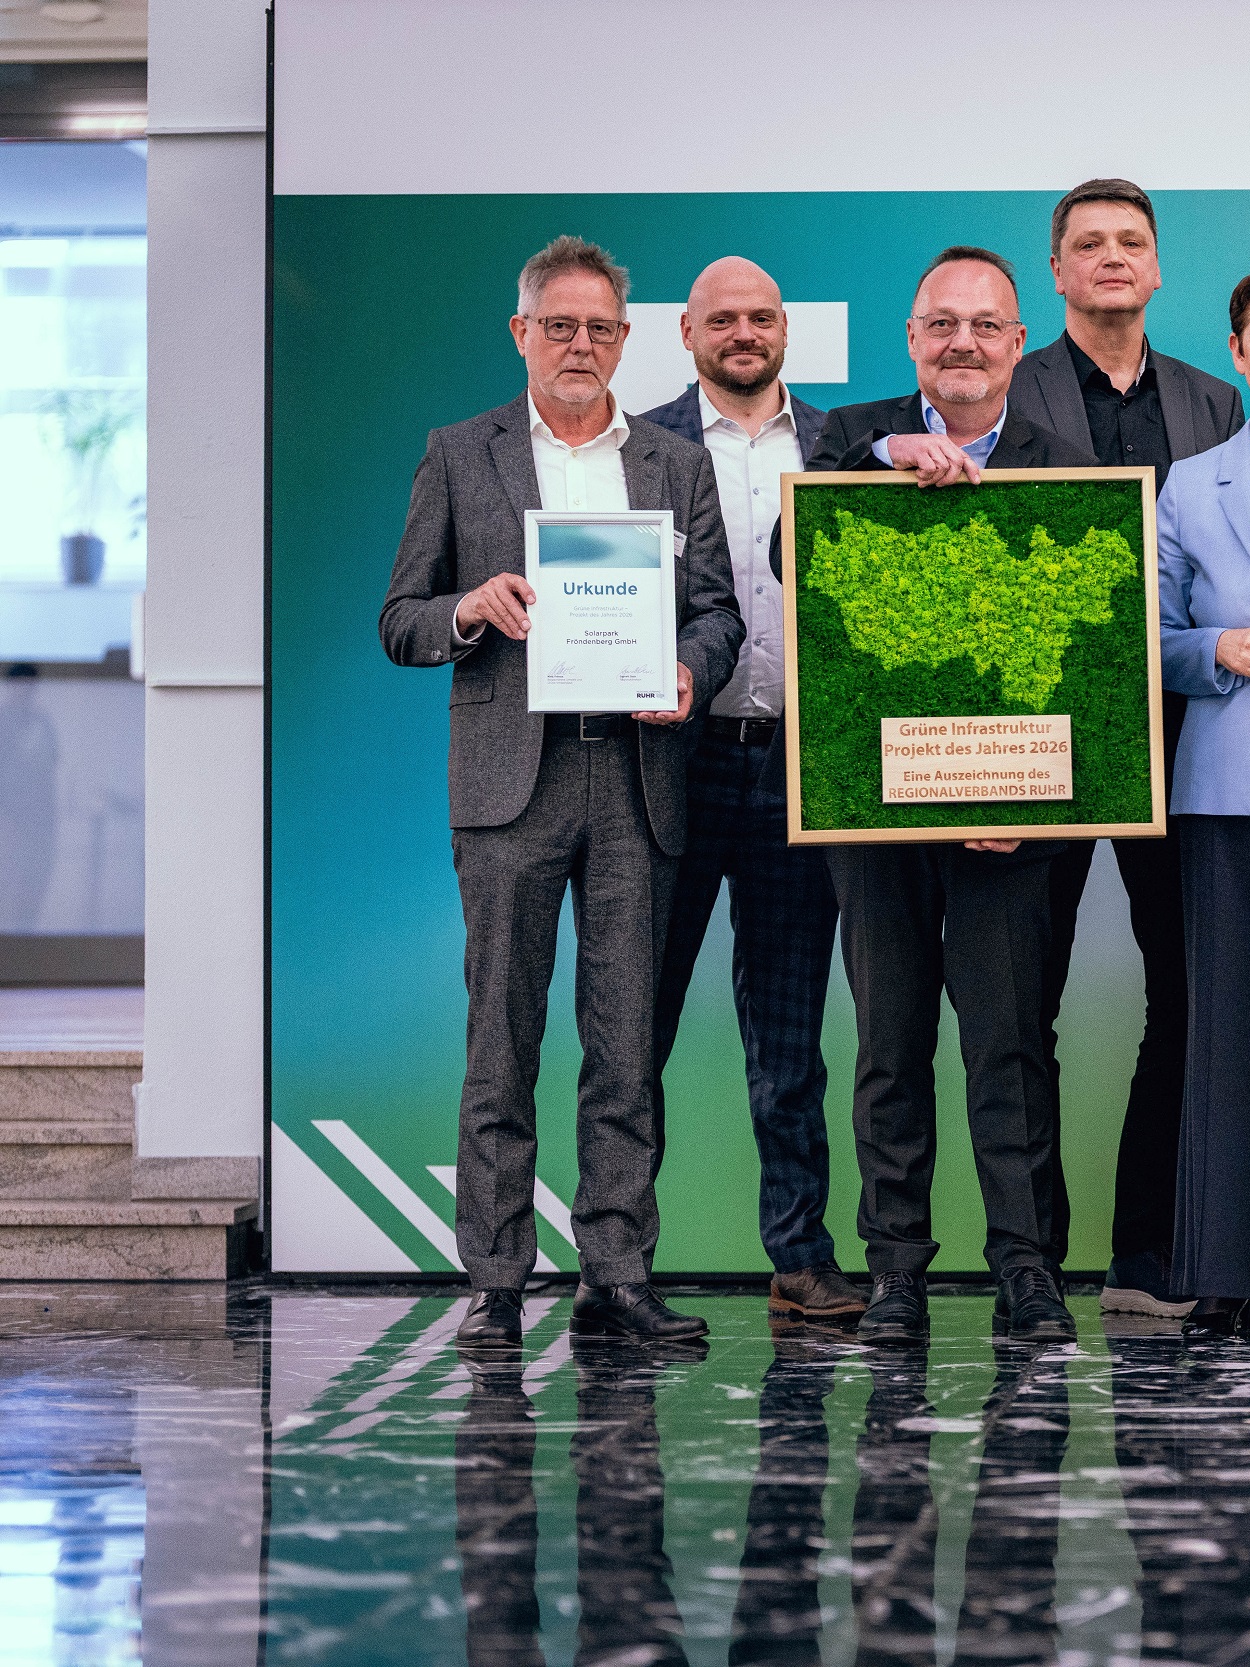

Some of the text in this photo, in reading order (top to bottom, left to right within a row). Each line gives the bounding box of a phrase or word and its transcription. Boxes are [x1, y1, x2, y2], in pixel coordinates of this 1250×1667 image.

[563, 581, 638, 596] Urkunde
[584, 630, 619, 638] Solarpark
[566, 638, 613, 646] Fröndenberg
[899, 720, 1052, 737] Grüne Infrastruktur
[884, 740, 1068, 759] Projekt des Jahres 2026
[903, 768, 1050, 782] Eine Auszeichnung des
[888, 784, 1066, 799] REGIONALVERBANDS RUHR
